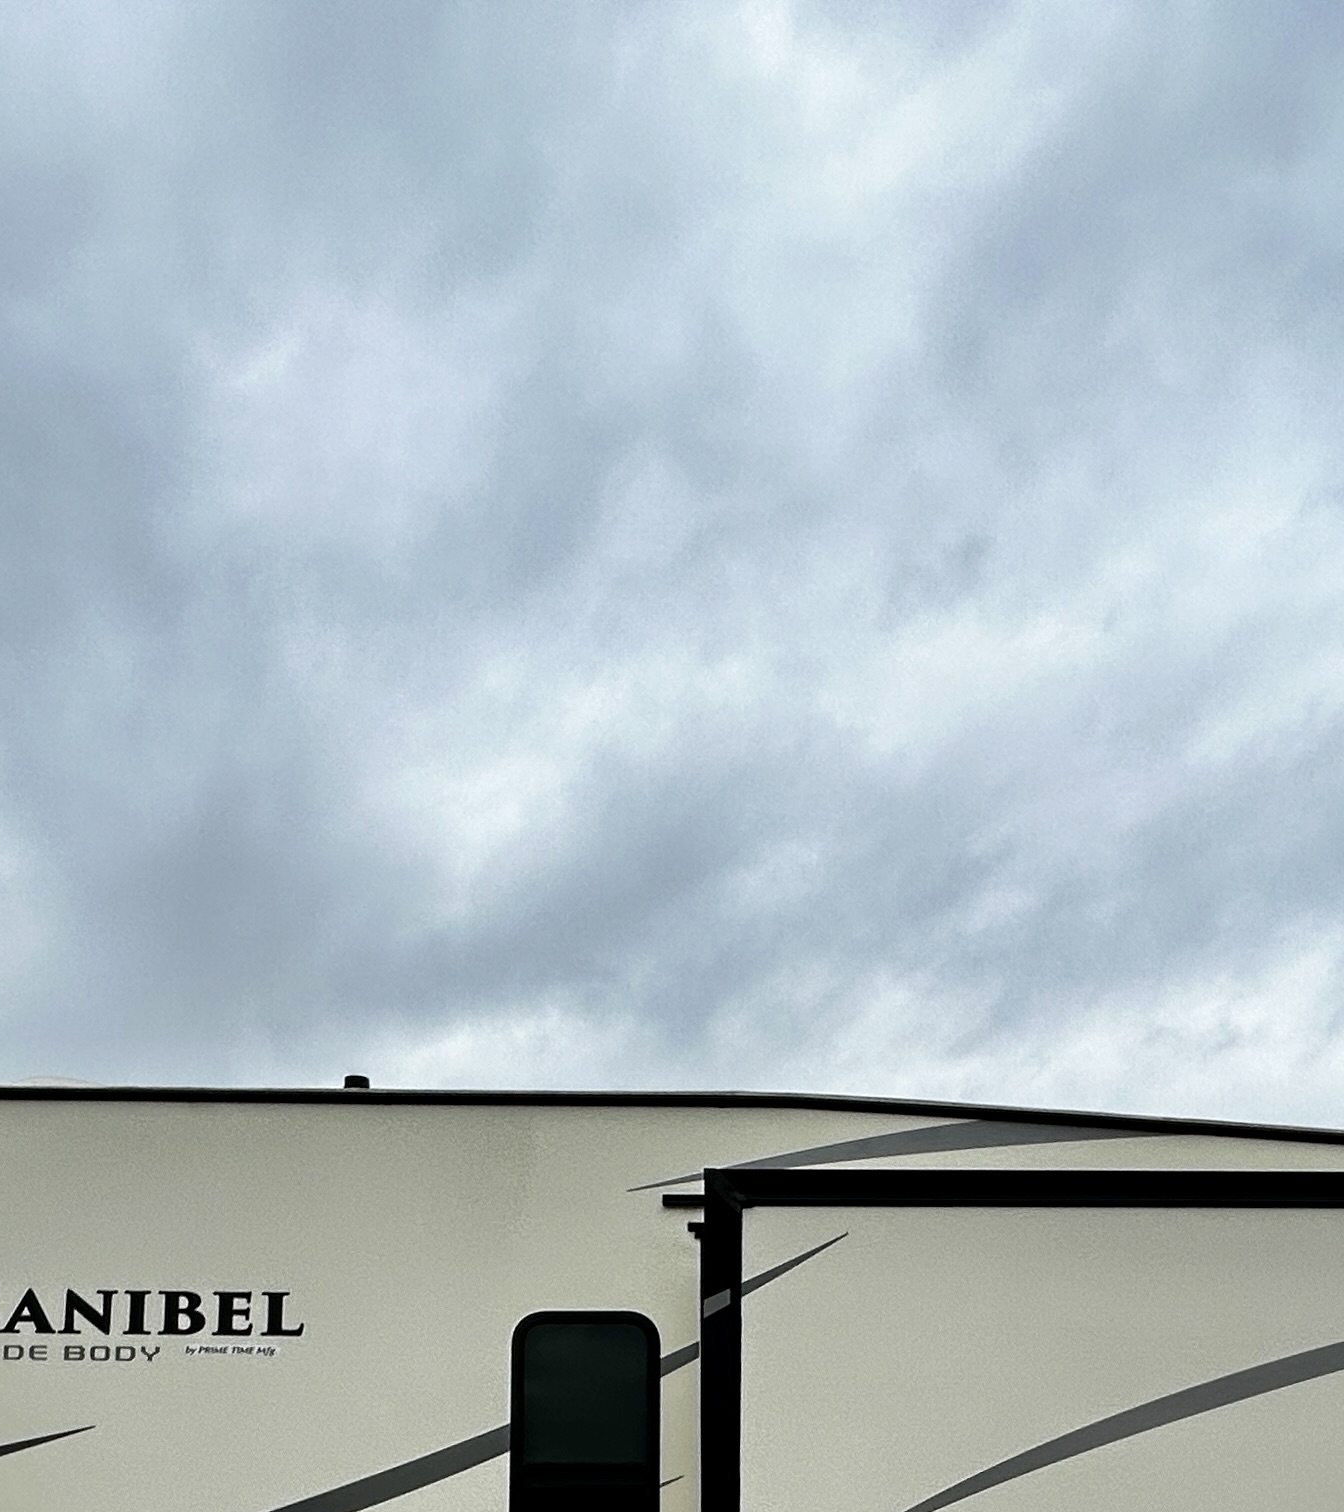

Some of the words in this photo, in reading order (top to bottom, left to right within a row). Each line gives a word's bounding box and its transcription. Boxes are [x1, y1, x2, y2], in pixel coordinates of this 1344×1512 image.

[63, 1345, 161, 1362] BODY
[185, 1345, 197, 1356] by
[197, 1346, 229, 1354] PRIME
[231, 1346, 255, 1355] TIME
